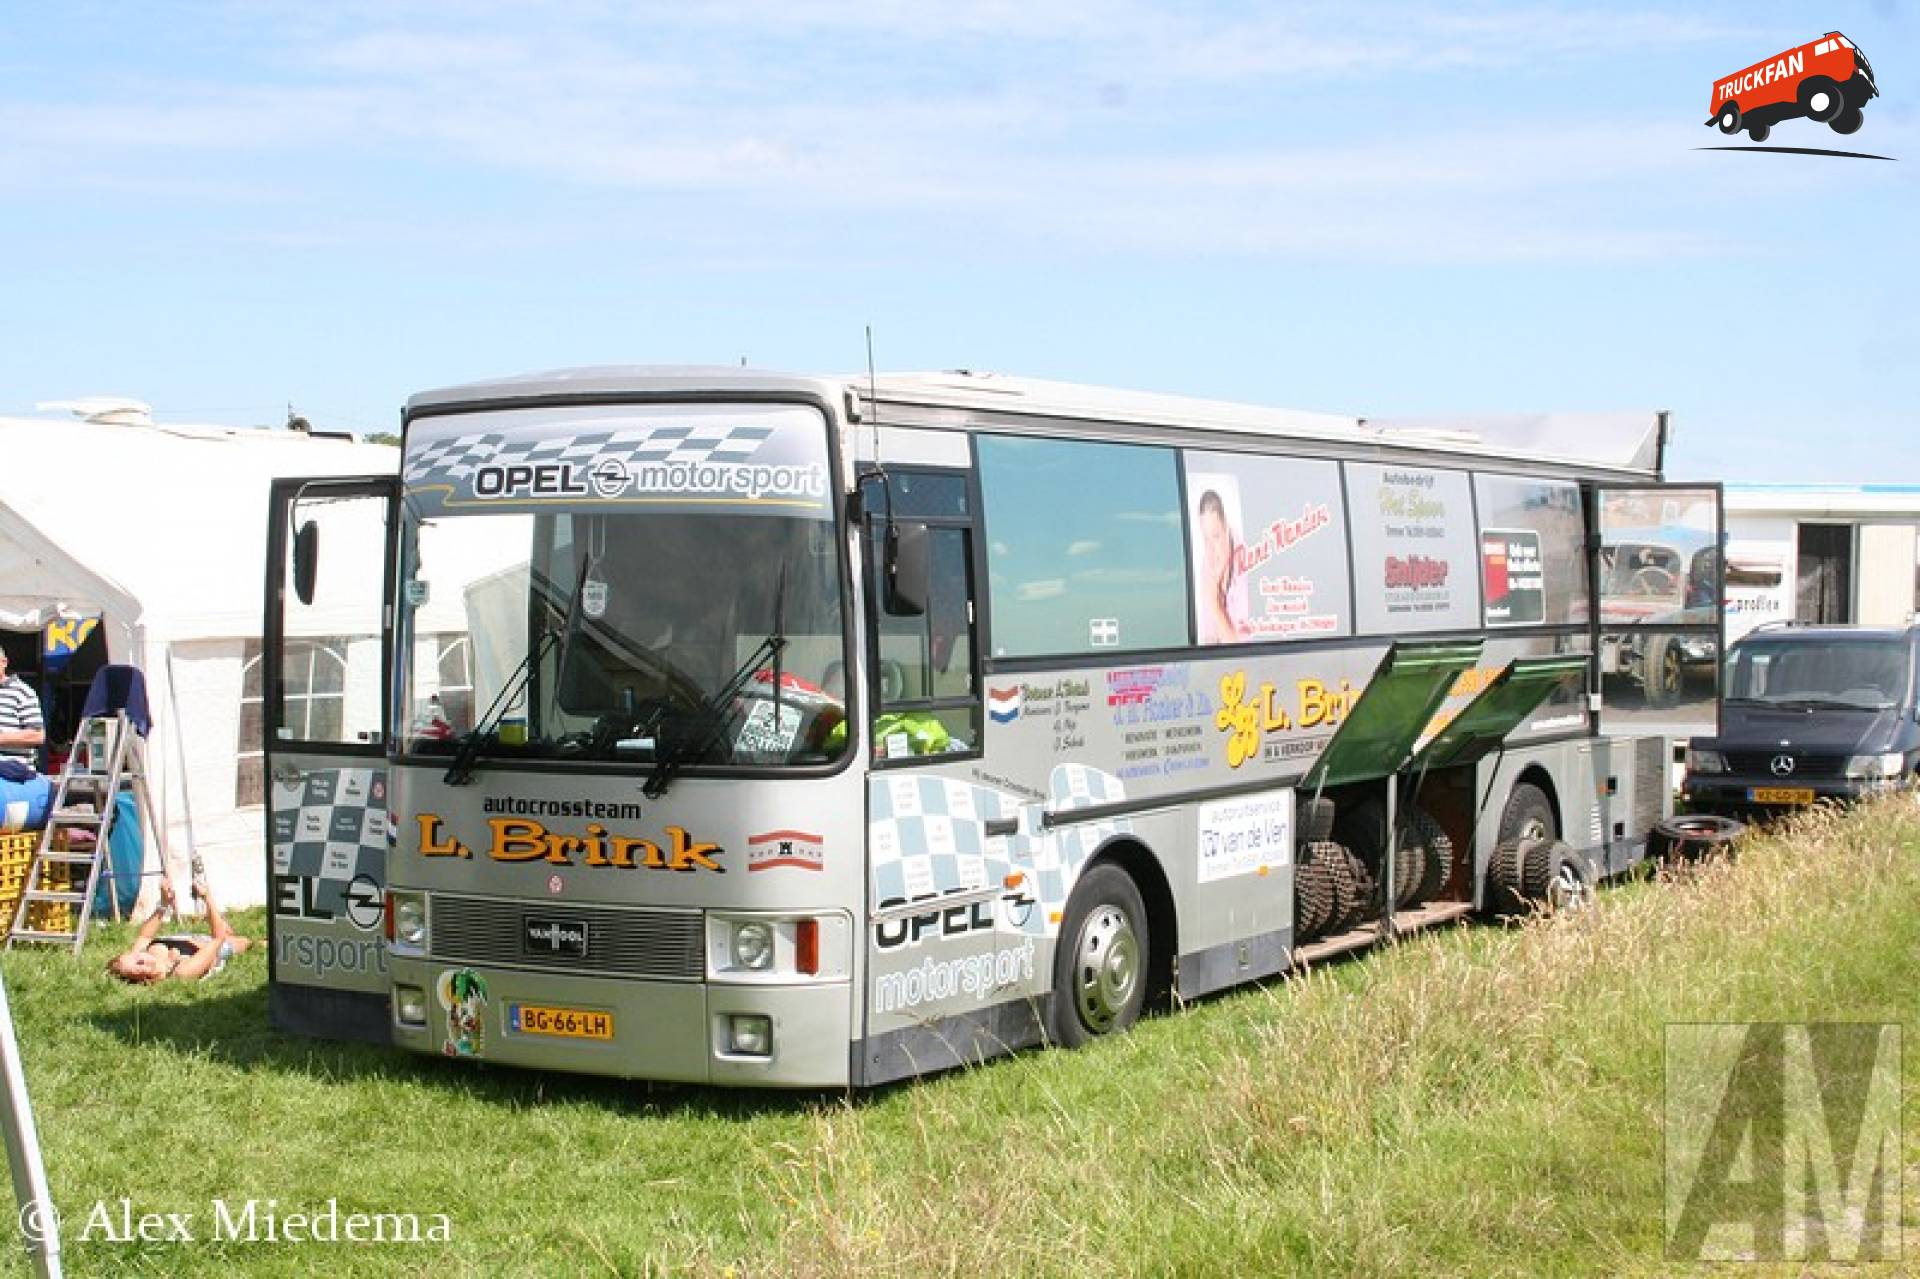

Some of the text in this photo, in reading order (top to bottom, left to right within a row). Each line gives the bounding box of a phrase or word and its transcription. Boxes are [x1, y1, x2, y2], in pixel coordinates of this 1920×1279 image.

[477, 460, 824, 498] OPEL motorsport
[1297, 677, 1363, 729] Bri
[483, 795, 641, 819] autocrossteam
[416, 812, 727, 873] L. Brink
[276, 875, 333, 919] EL
[876, 887, 995, 949] OPEL
[281, 933, 388, 977] rsport
[875, 938, 1037, 1014] motorsport
[524, 1008, 607, 1035] BG-66-LH
